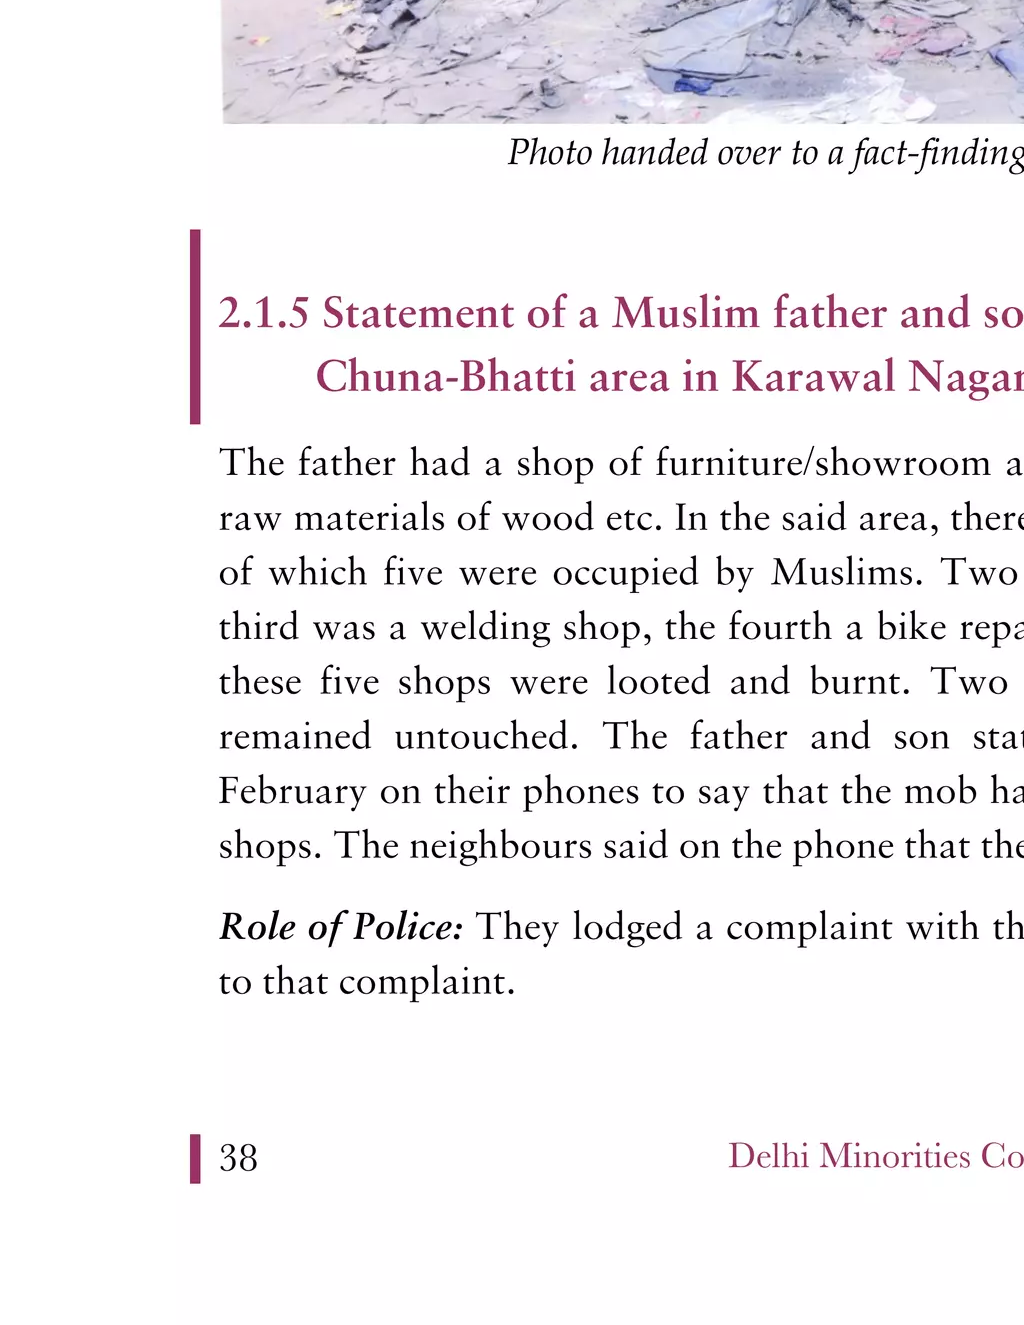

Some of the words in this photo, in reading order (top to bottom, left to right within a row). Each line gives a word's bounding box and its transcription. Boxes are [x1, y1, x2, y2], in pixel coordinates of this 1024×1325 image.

[507, 136, 593, 166] Photo
[601, 136, 709, 166] handed
[717, 146, 782, 166] over
[792, 140, 819, 166] to
[827, 146, 844, 166] a
[218, 295, 309, 329] 2.1.5
[323, 295, 515, 329] Statement
[527, 292, 568, 329] of
[579, 306, 599, 329] a
[611, 293, 760, 329] Muslim
[773, 292, 888, 329] father
[900, 293, 971, 329] and
[316, 356, 576, 392] Chuna-Bhatti
[589, 370, 670, 392] area
[682, 358, 719, 392] in
[732, 356, 896, 393] Karawal
[219, 1143, 258, 1172] 38
[728, 1141, 810, 1169] Delhi
[819, 1141, 971, 1169] Minorities
